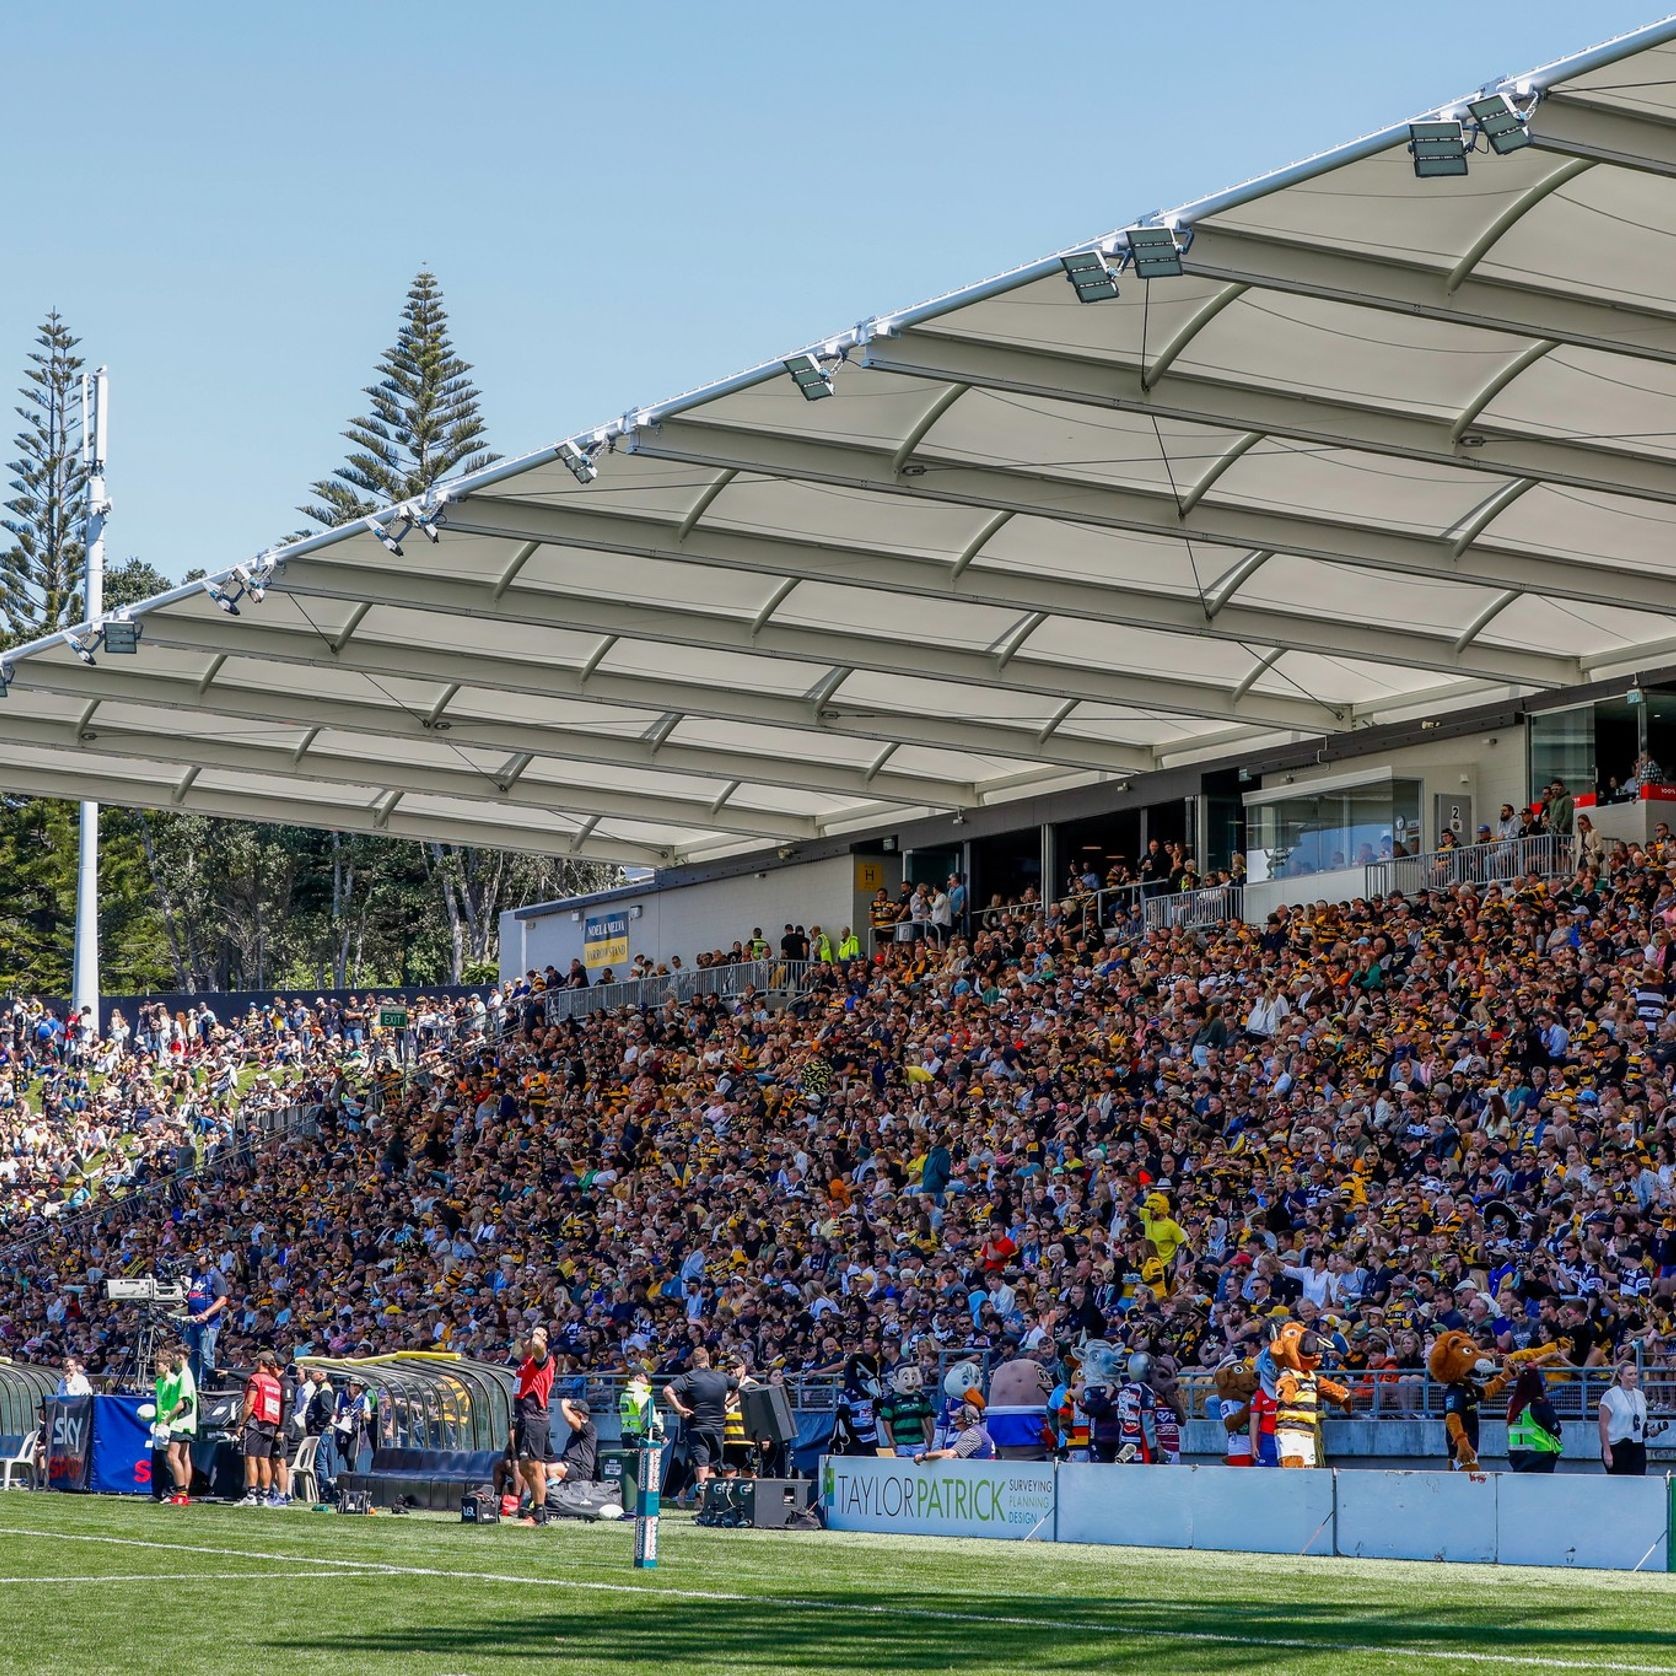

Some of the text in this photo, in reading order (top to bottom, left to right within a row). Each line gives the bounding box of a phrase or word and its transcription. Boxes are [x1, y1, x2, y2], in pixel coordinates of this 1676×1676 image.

[1452, 806, 1459, 819] 2
[865, 869, 874, 881] H
[384, 1014, 402, 1025] EXIT
[1009, 1479, 1052, 1494] SURVEYING
[1009, 1496, 1049, 1509] PLANNING
[1009, 1512, 1037, 1525] DESIGN
